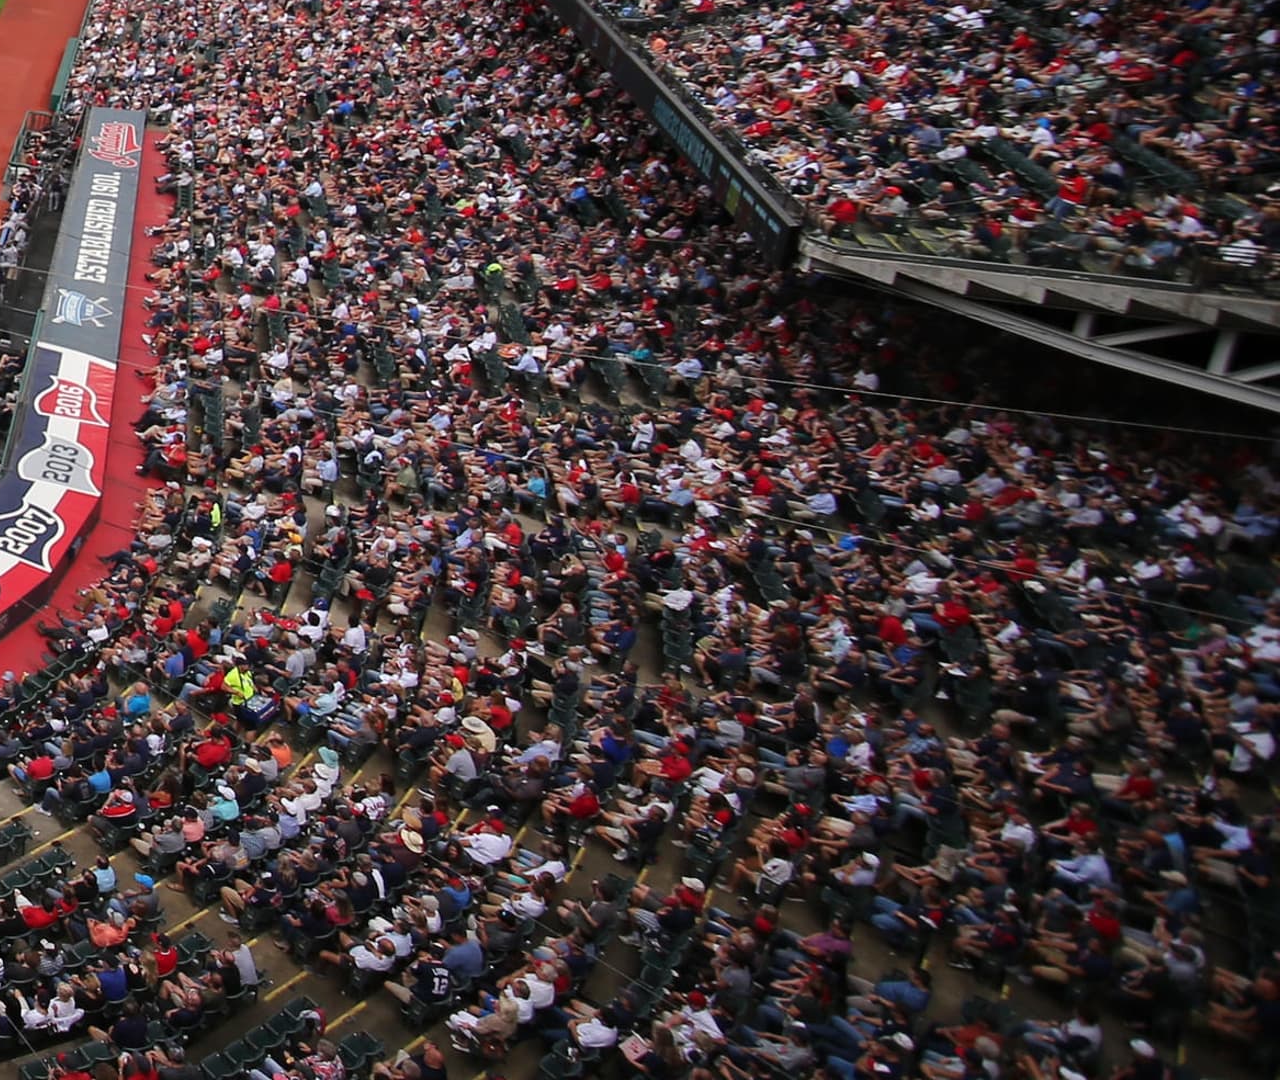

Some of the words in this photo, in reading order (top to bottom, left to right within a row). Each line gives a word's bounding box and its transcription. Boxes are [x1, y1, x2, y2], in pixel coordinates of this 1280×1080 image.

[88, 121, 142, 168] Indians
[94, 171, 121, 199] 1901.
[73, 197, 116, 284] ESTABLISHED
[54, 385, 84, 418] 2016
[42, 442, 80, 483] 2013
[432, 977, 449, 995] 12
